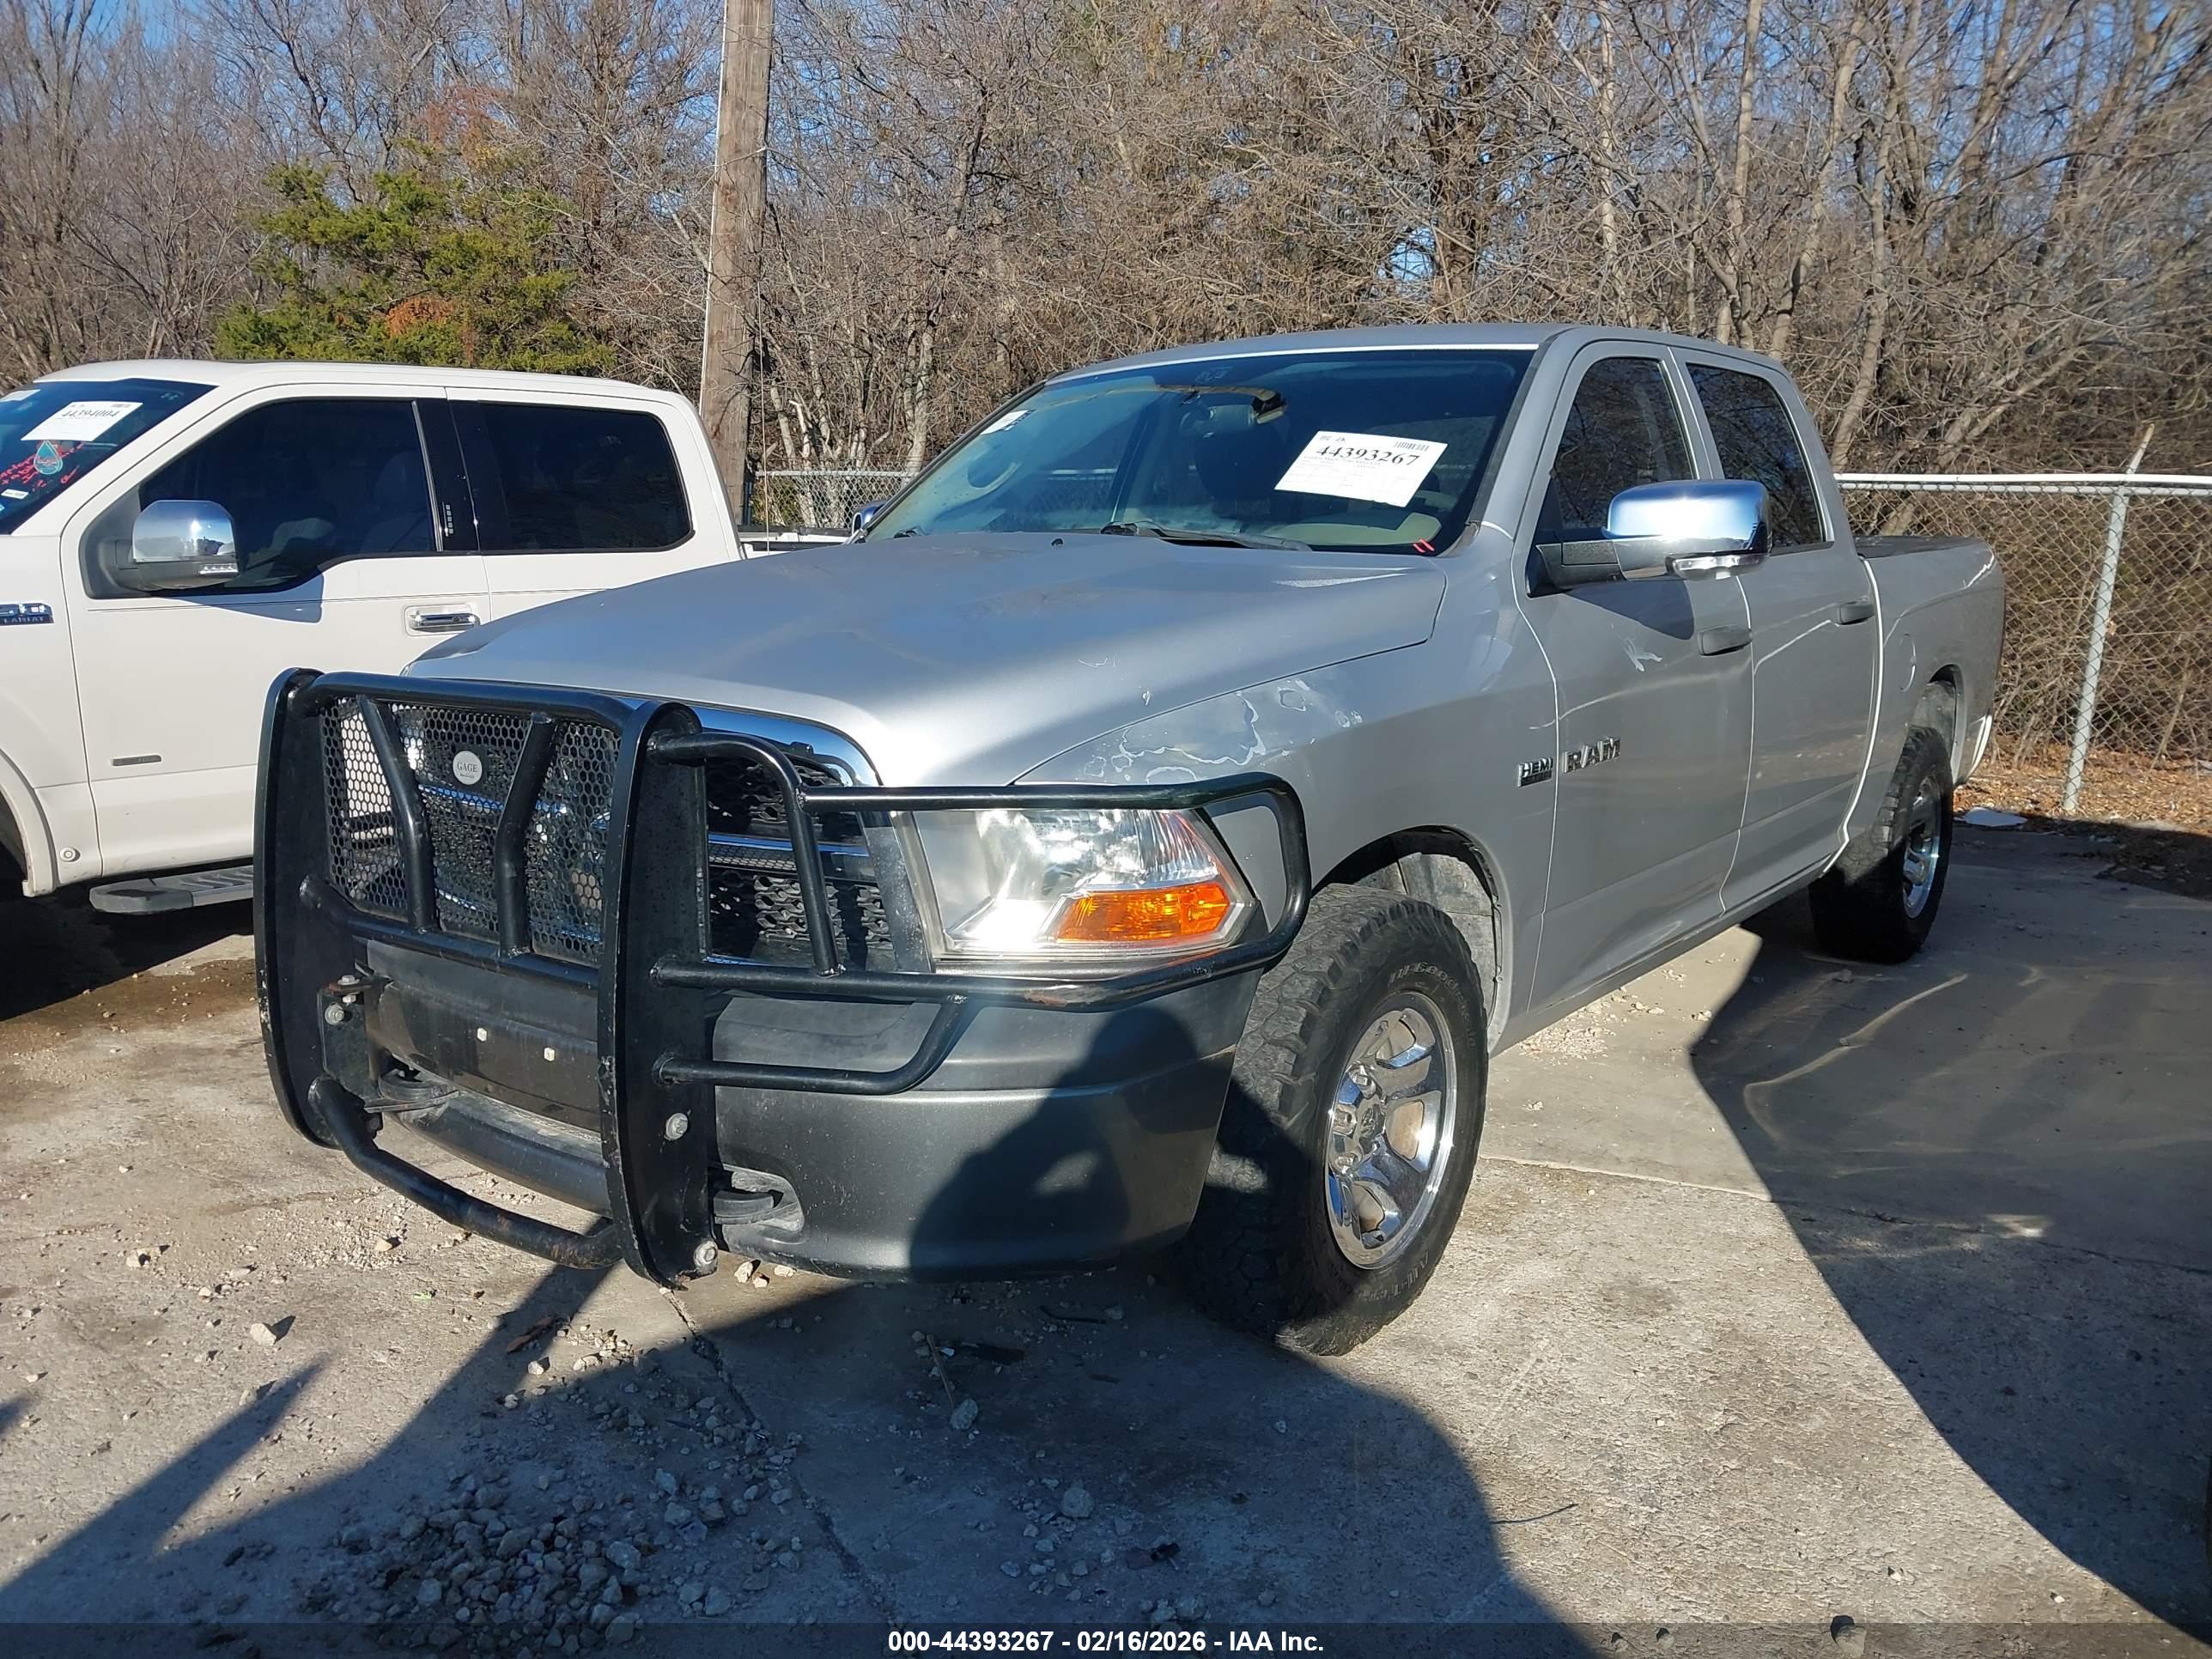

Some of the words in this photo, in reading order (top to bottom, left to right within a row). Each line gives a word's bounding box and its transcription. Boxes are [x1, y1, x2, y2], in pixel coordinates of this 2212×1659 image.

[1316, 446, 1421, 466] 44393267
[1563, 738, 1621, 774] RAM
[457, 762, 478, 773] GAGE
[1518, 757, 1554, 777] HEMI
